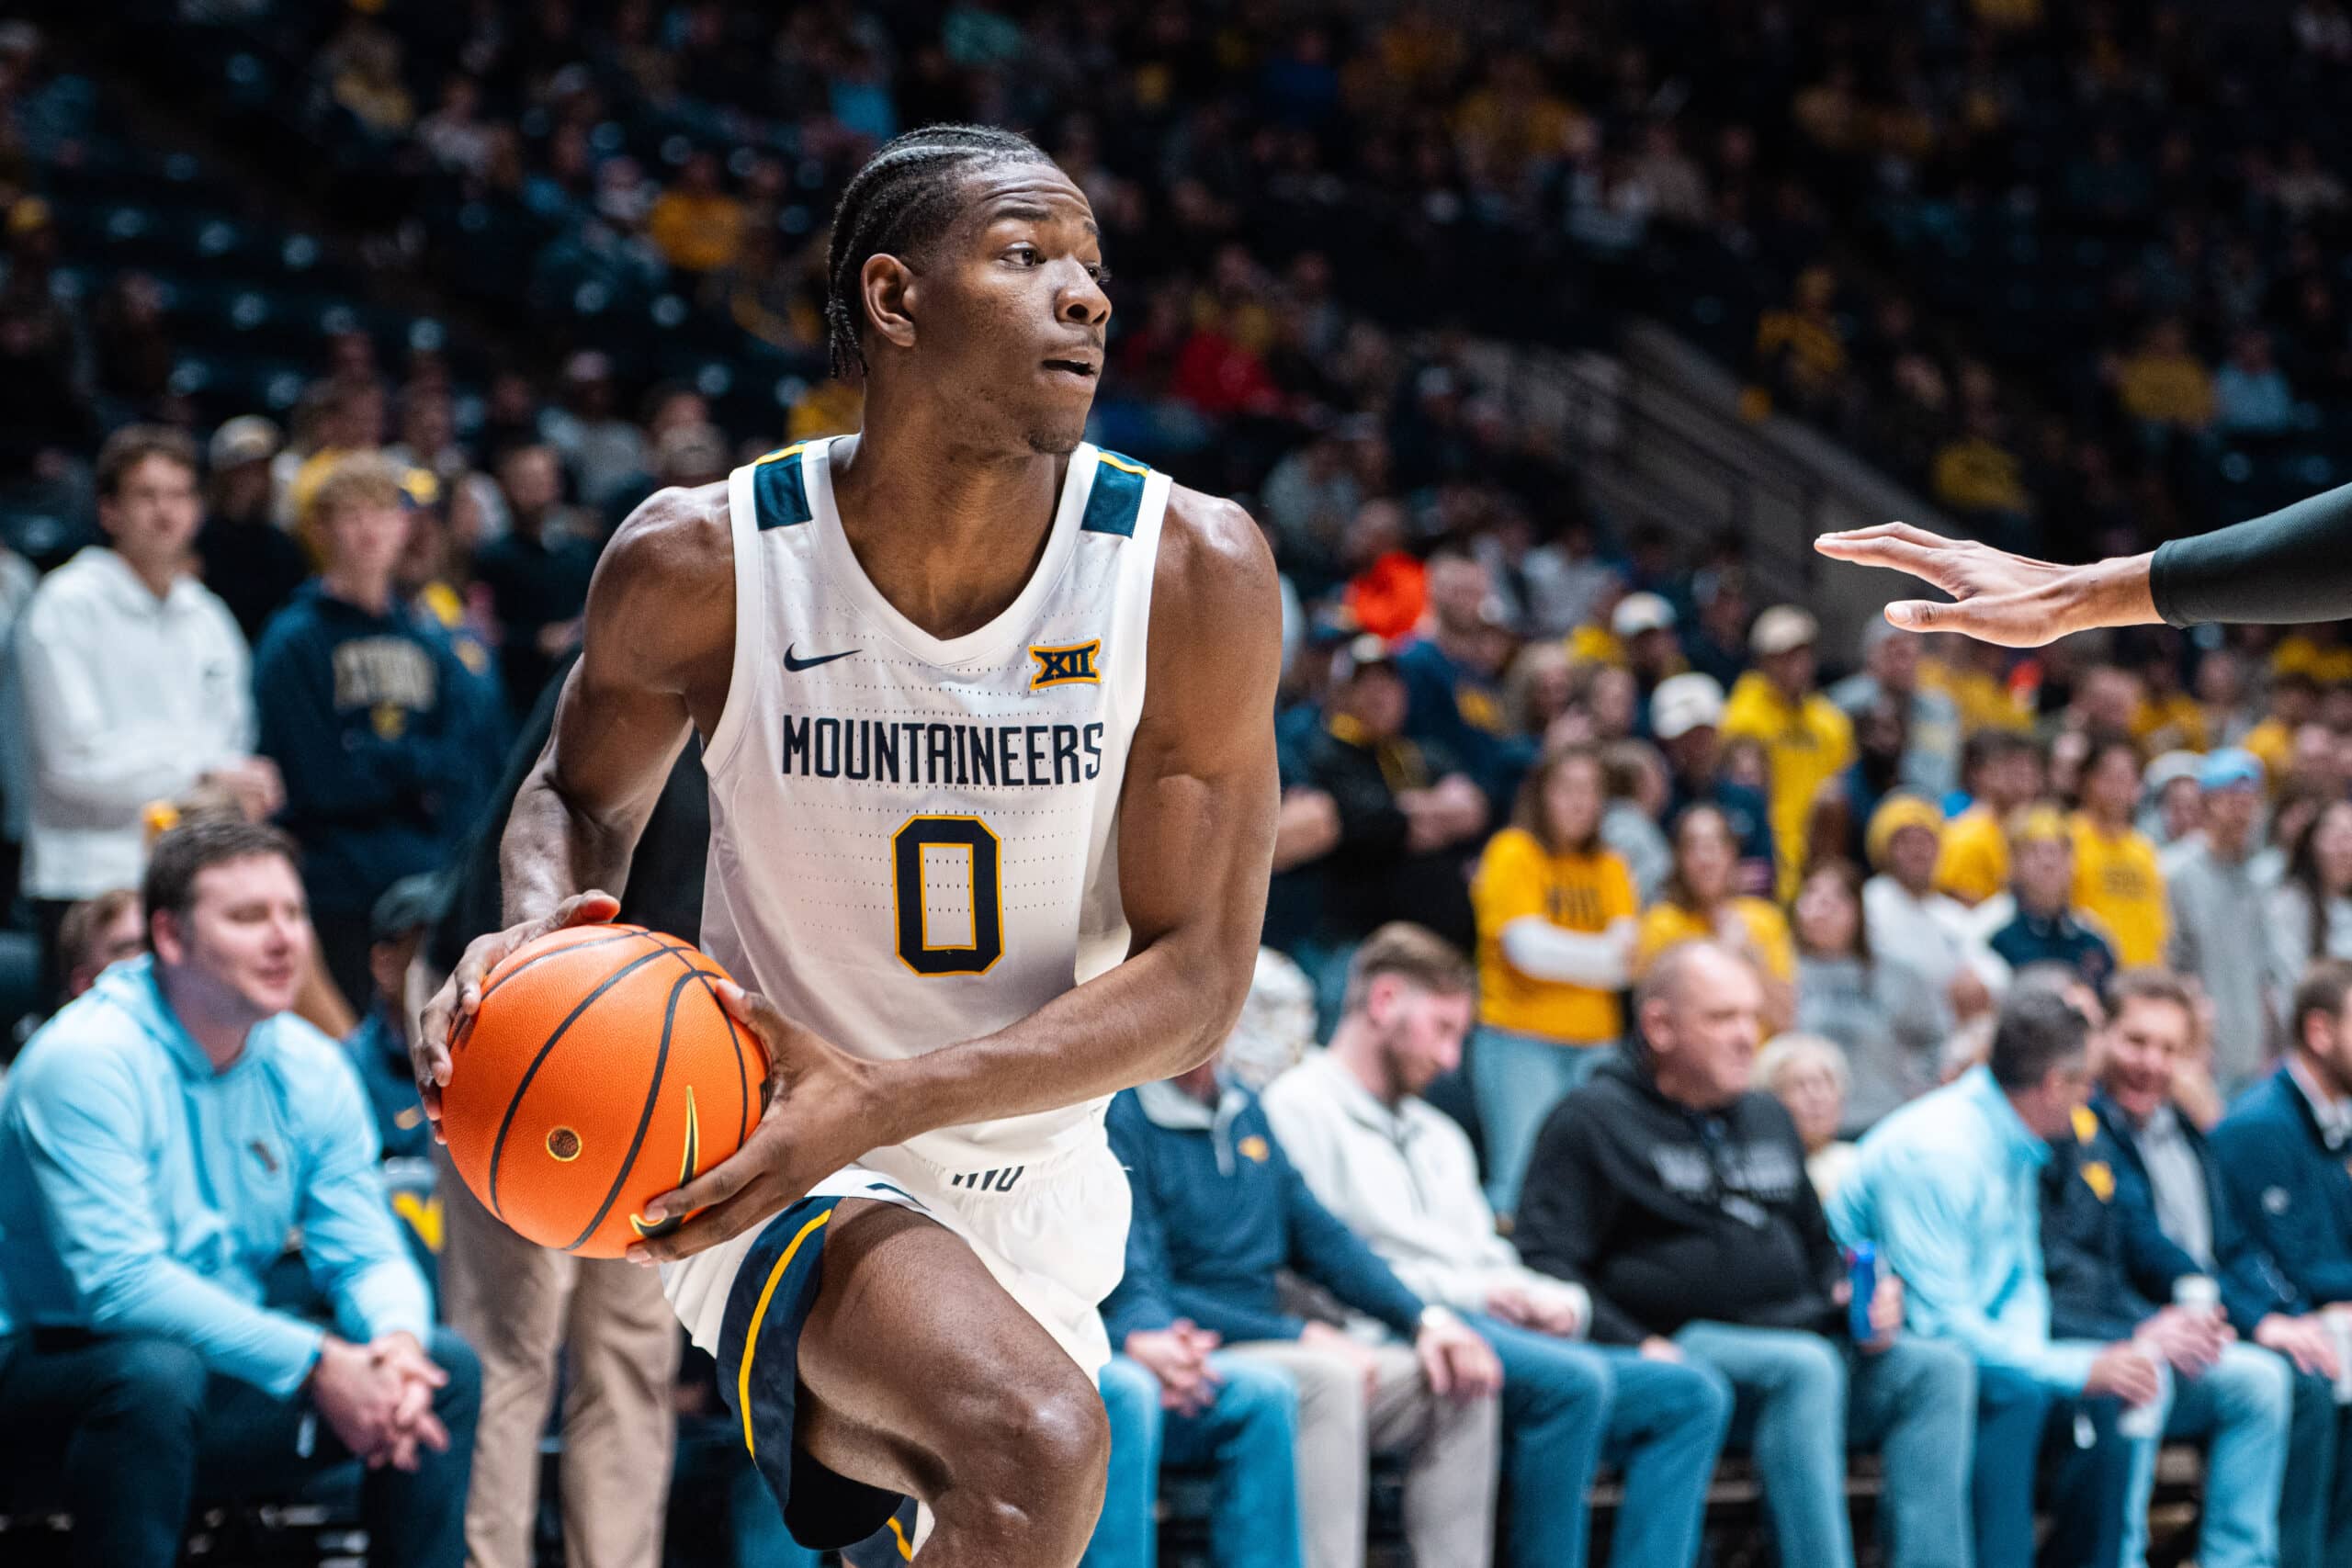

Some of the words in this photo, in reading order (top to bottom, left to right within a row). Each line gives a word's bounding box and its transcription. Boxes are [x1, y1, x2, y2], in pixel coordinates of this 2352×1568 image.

[1033, 644, 1100, 686] XII
[782, 714, 1103, 786] MOUNTAINEERS
[890, 814, 1005, 977] 0
